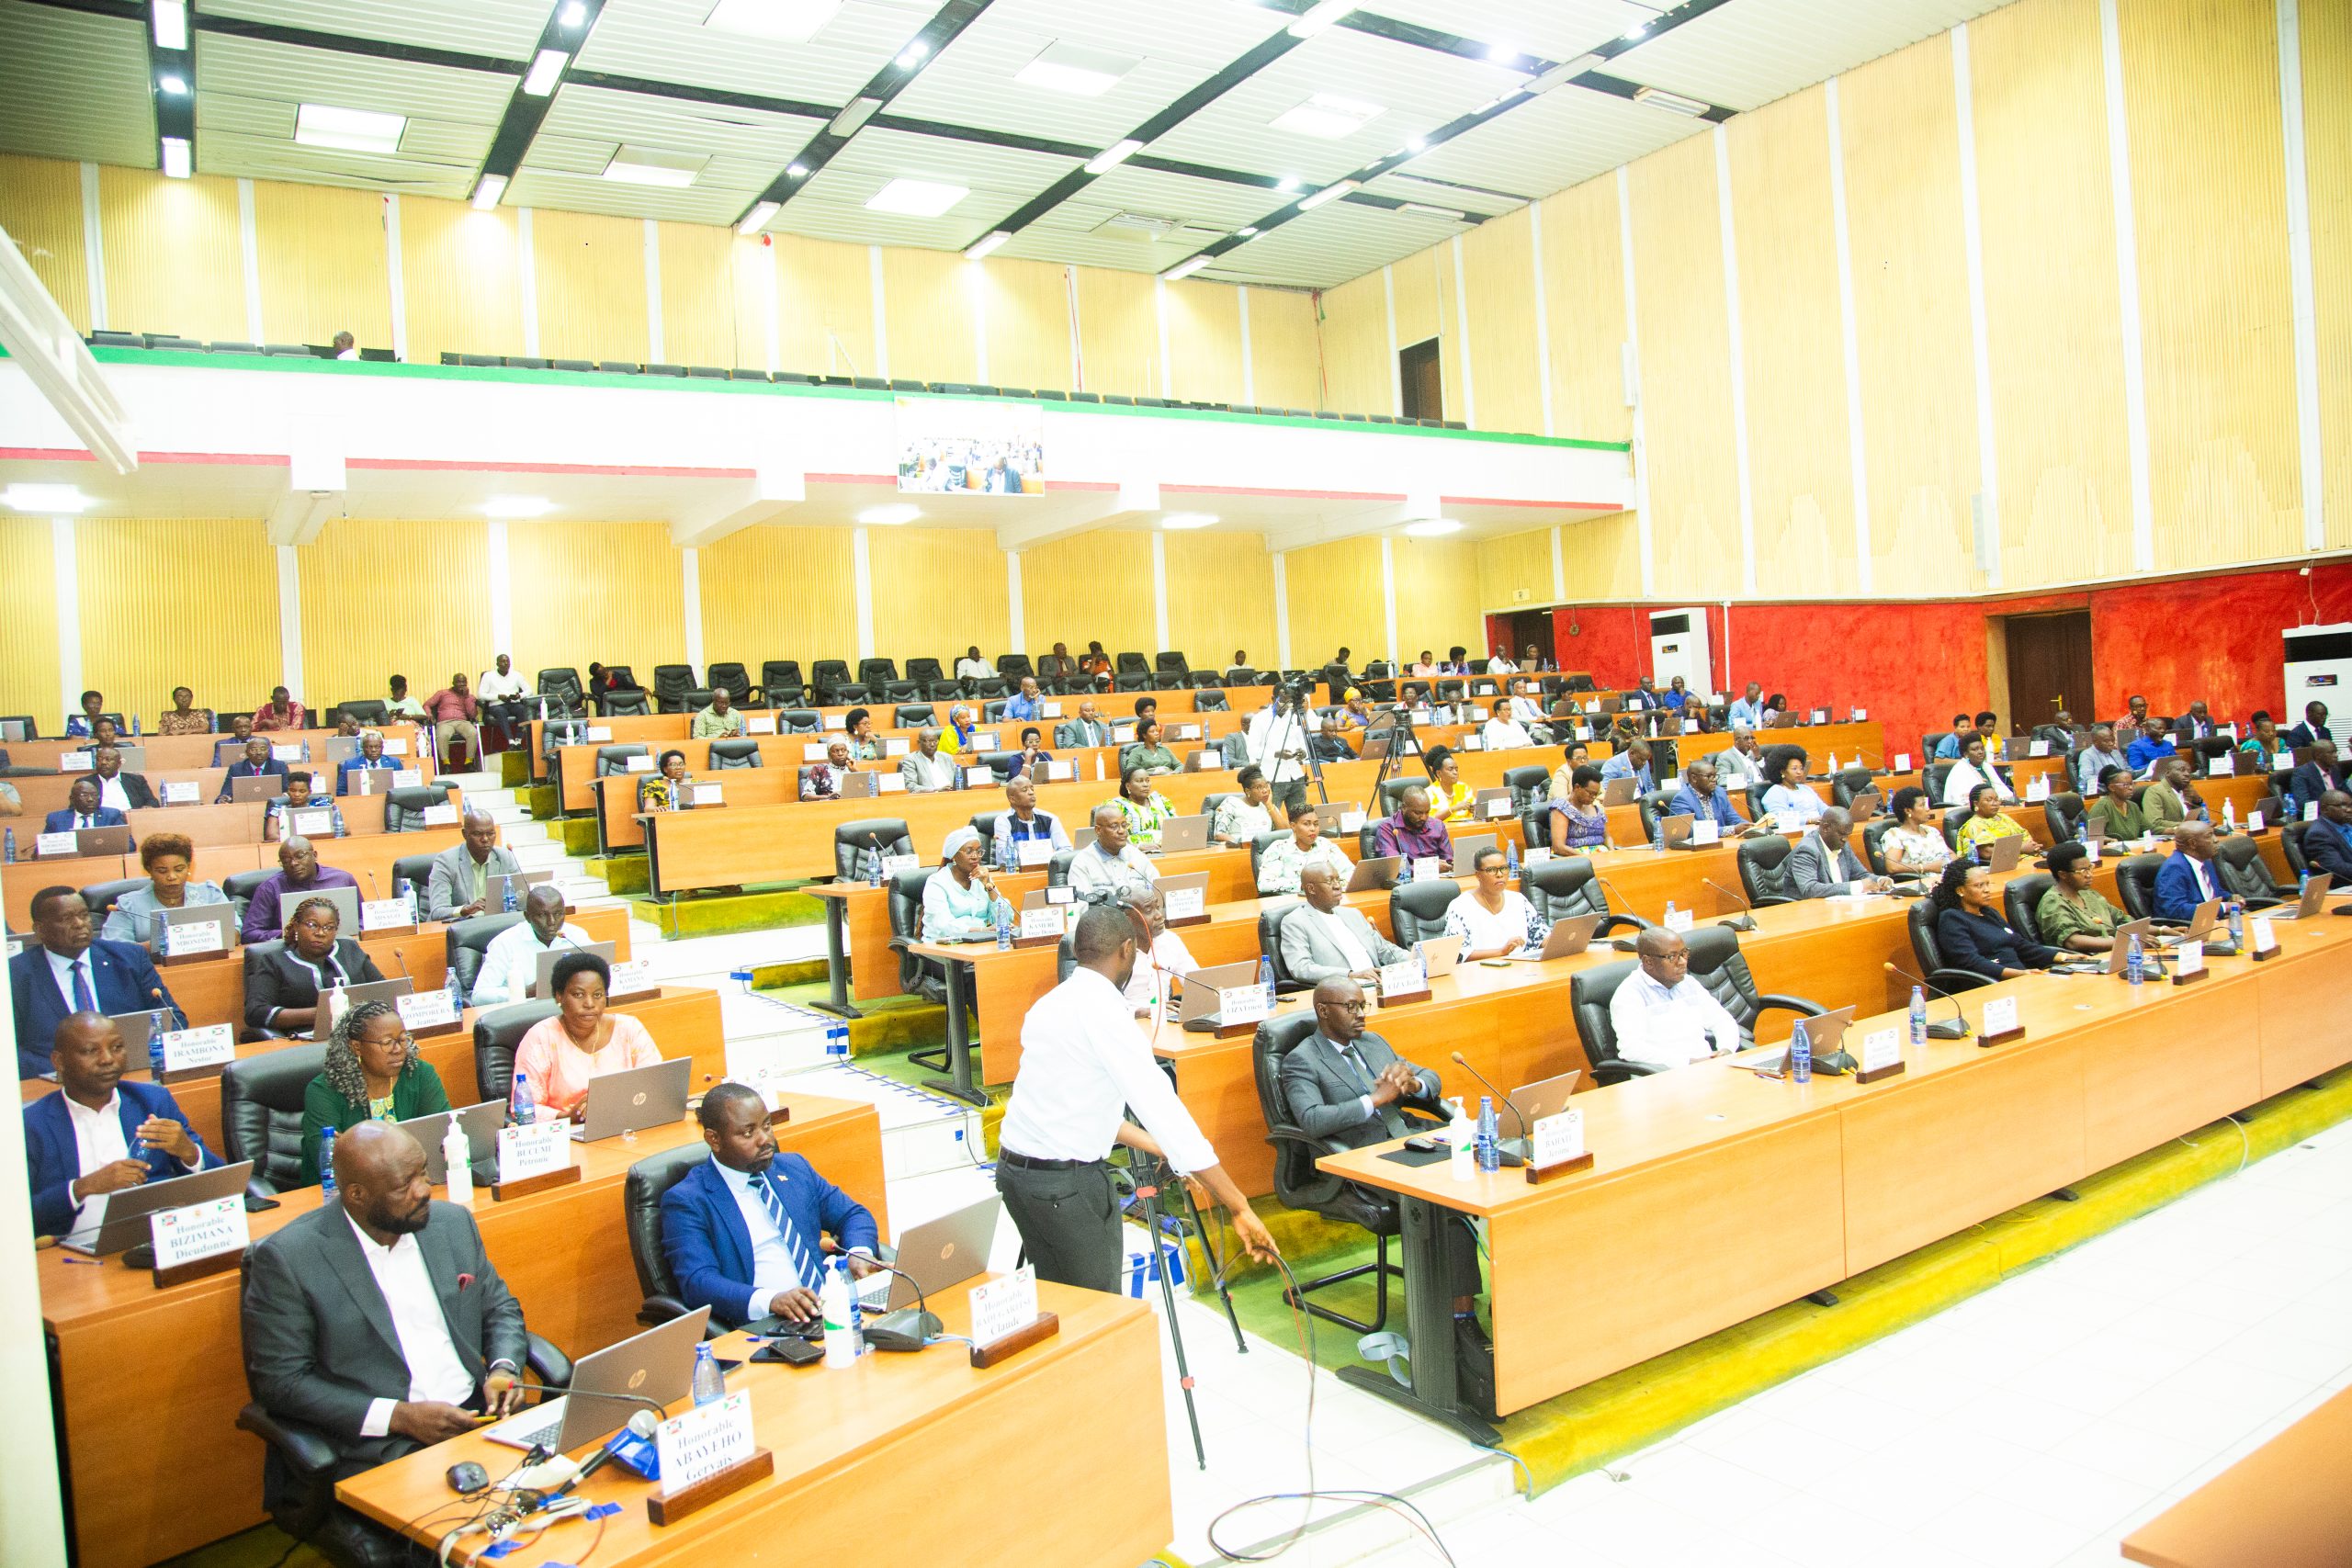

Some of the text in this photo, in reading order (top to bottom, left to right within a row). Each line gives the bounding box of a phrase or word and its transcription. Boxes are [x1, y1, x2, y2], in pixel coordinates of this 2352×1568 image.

[173, 1044, 225, 1057] IRAMBONA
[181, 1037, 217, 1048] Honorable
[514, 1135, 553, 1148] Honorable
[515, 1145, 551, 1157] BUCUMI
[176, 1216, 225, 1235] Honorable
[170, 1225, 233, 1248] BIZIMANA
[984, 1290, 1023, 1313] Honorable
[990, 1316, 1020, 1336] Claude
[678, 1417, 735, 1450] Honorable
[673, 1430, 742, 1469] ABAYEHO
[685, 1454, 733, 1482] Gervais
